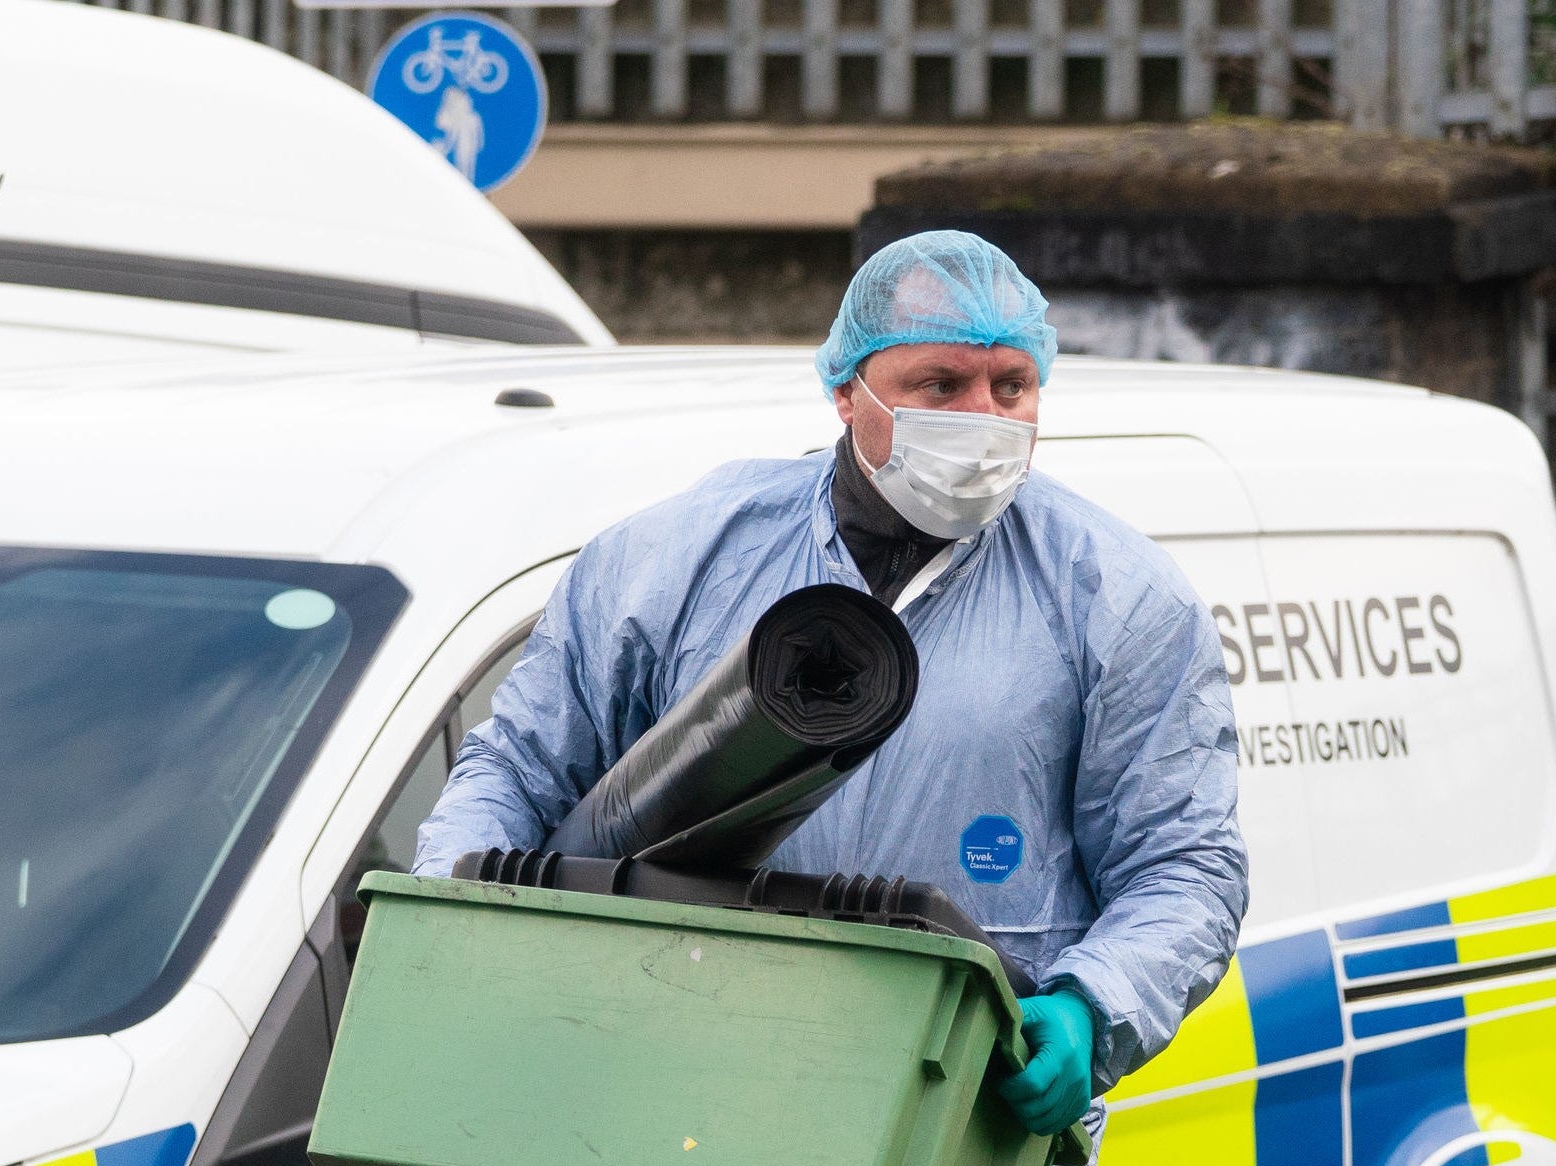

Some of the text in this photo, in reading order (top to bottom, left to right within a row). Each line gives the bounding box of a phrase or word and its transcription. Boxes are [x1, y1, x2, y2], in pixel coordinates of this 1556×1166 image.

[1211, 594, 1462, 685] SERVICES
[969, 862, 1009, 871] Classic Xpert
